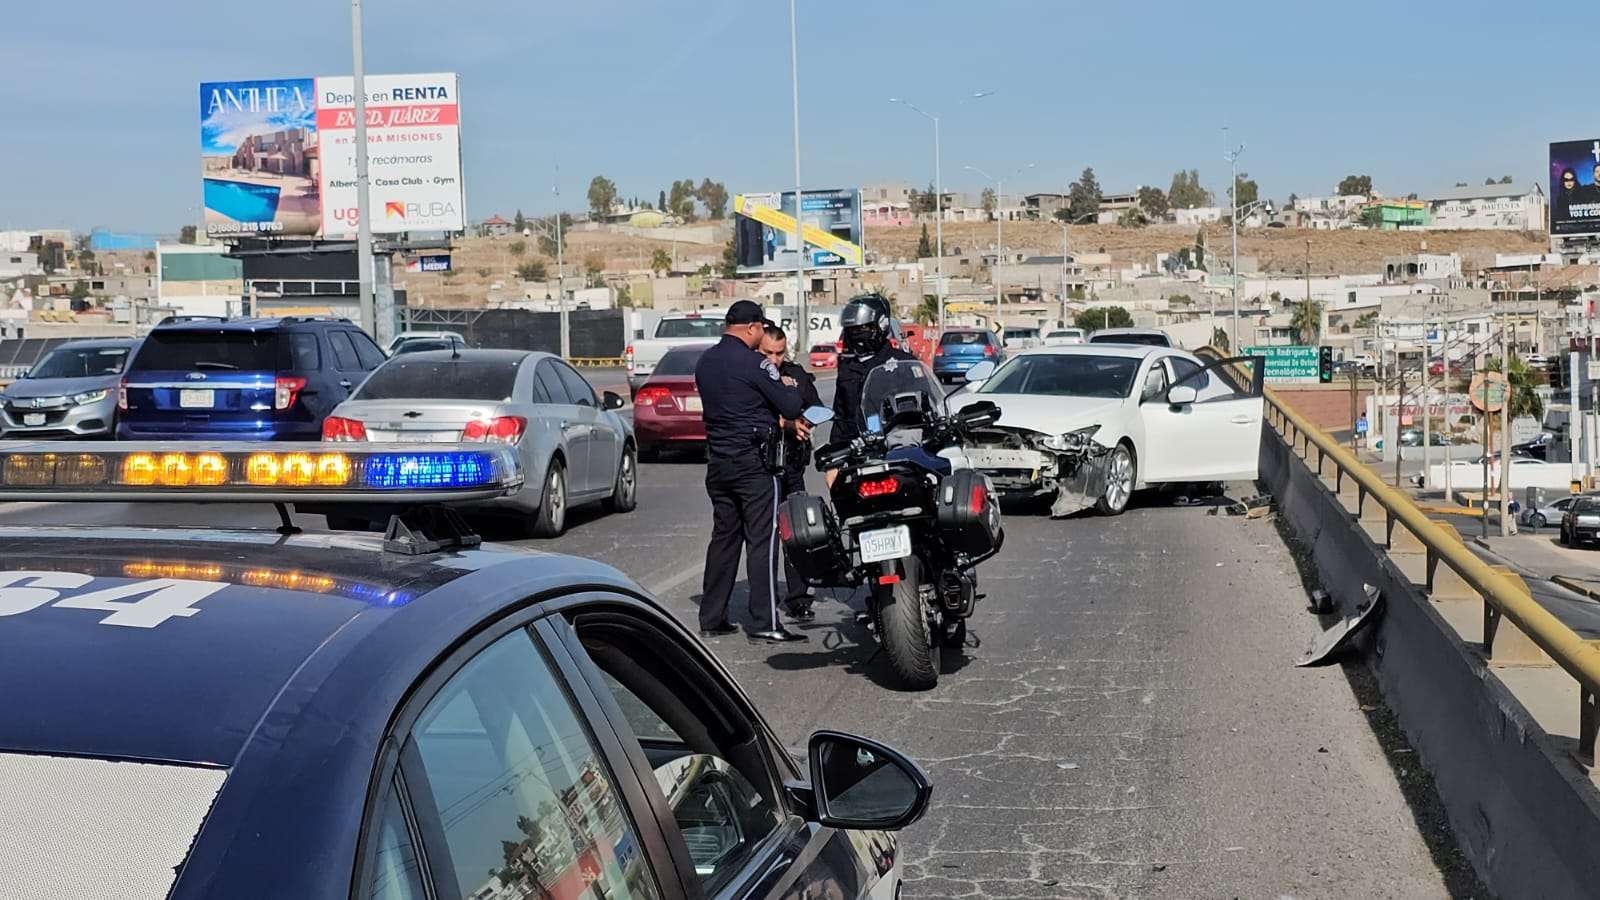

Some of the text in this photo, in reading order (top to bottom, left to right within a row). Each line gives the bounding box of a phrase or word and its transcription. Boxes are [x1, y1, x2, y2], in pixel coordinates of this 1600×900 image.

[208, 86, 306, 114] ANTHEA
[326, 87, 448, 105] Deps en RENTA
[387, 106, 441, 128] JUÁREZ
[352, 135, 383, 144] ZNA
[386, 133, 443, 143] MISIONES
[372, 154, 433, 166] recámaras
[329, 175, 456, 188] Alberc Casa Club Gym
[407, 201, 456, 218] RUBA
